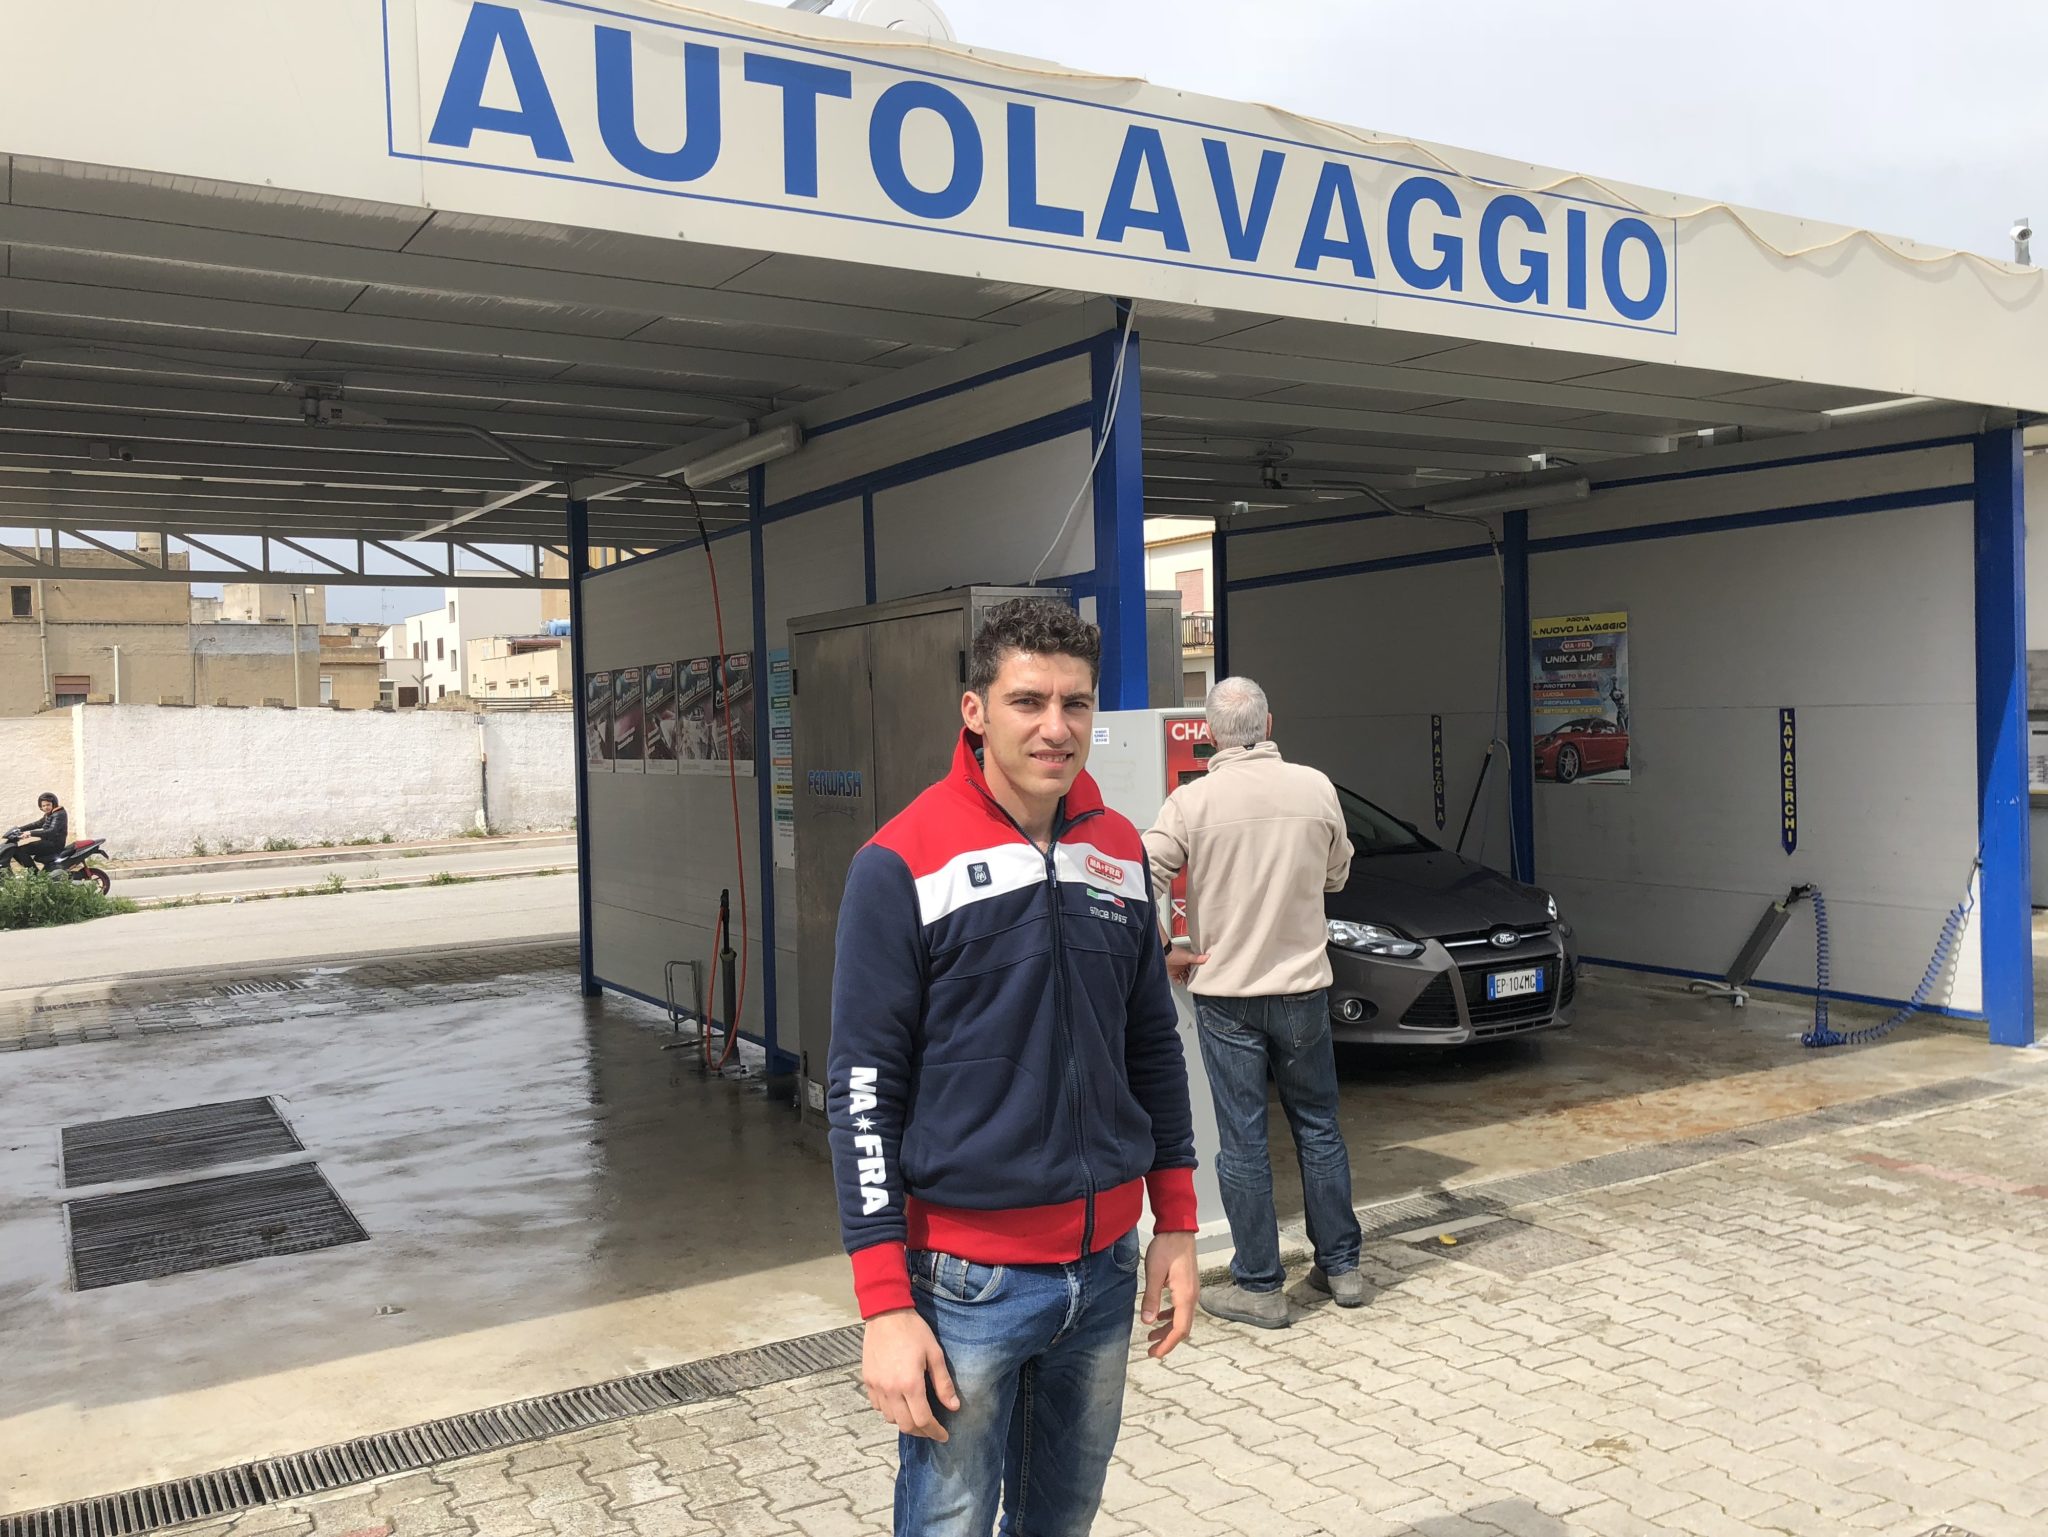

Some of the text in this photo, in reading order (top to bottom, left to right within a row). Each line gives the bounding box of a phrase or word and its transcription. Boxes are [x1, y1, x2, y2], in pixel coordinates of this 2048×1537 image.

[428, 1, 1667, 321] AUTOLAVAGGIO
[1539, 625, 1574, 635] NUOVO
[1576, 621, 1627, 632] LAVAGGIO
[1545, 653, 1603, 664] UNIKA LINE
[1171, 722, 1210, 741] CHA
[1432, 716, 1444, 821] SPAZZOLA
[1783, 711, 1795, 843] LAVACERCHI
[808, 770, 862, 798] FERWASH
